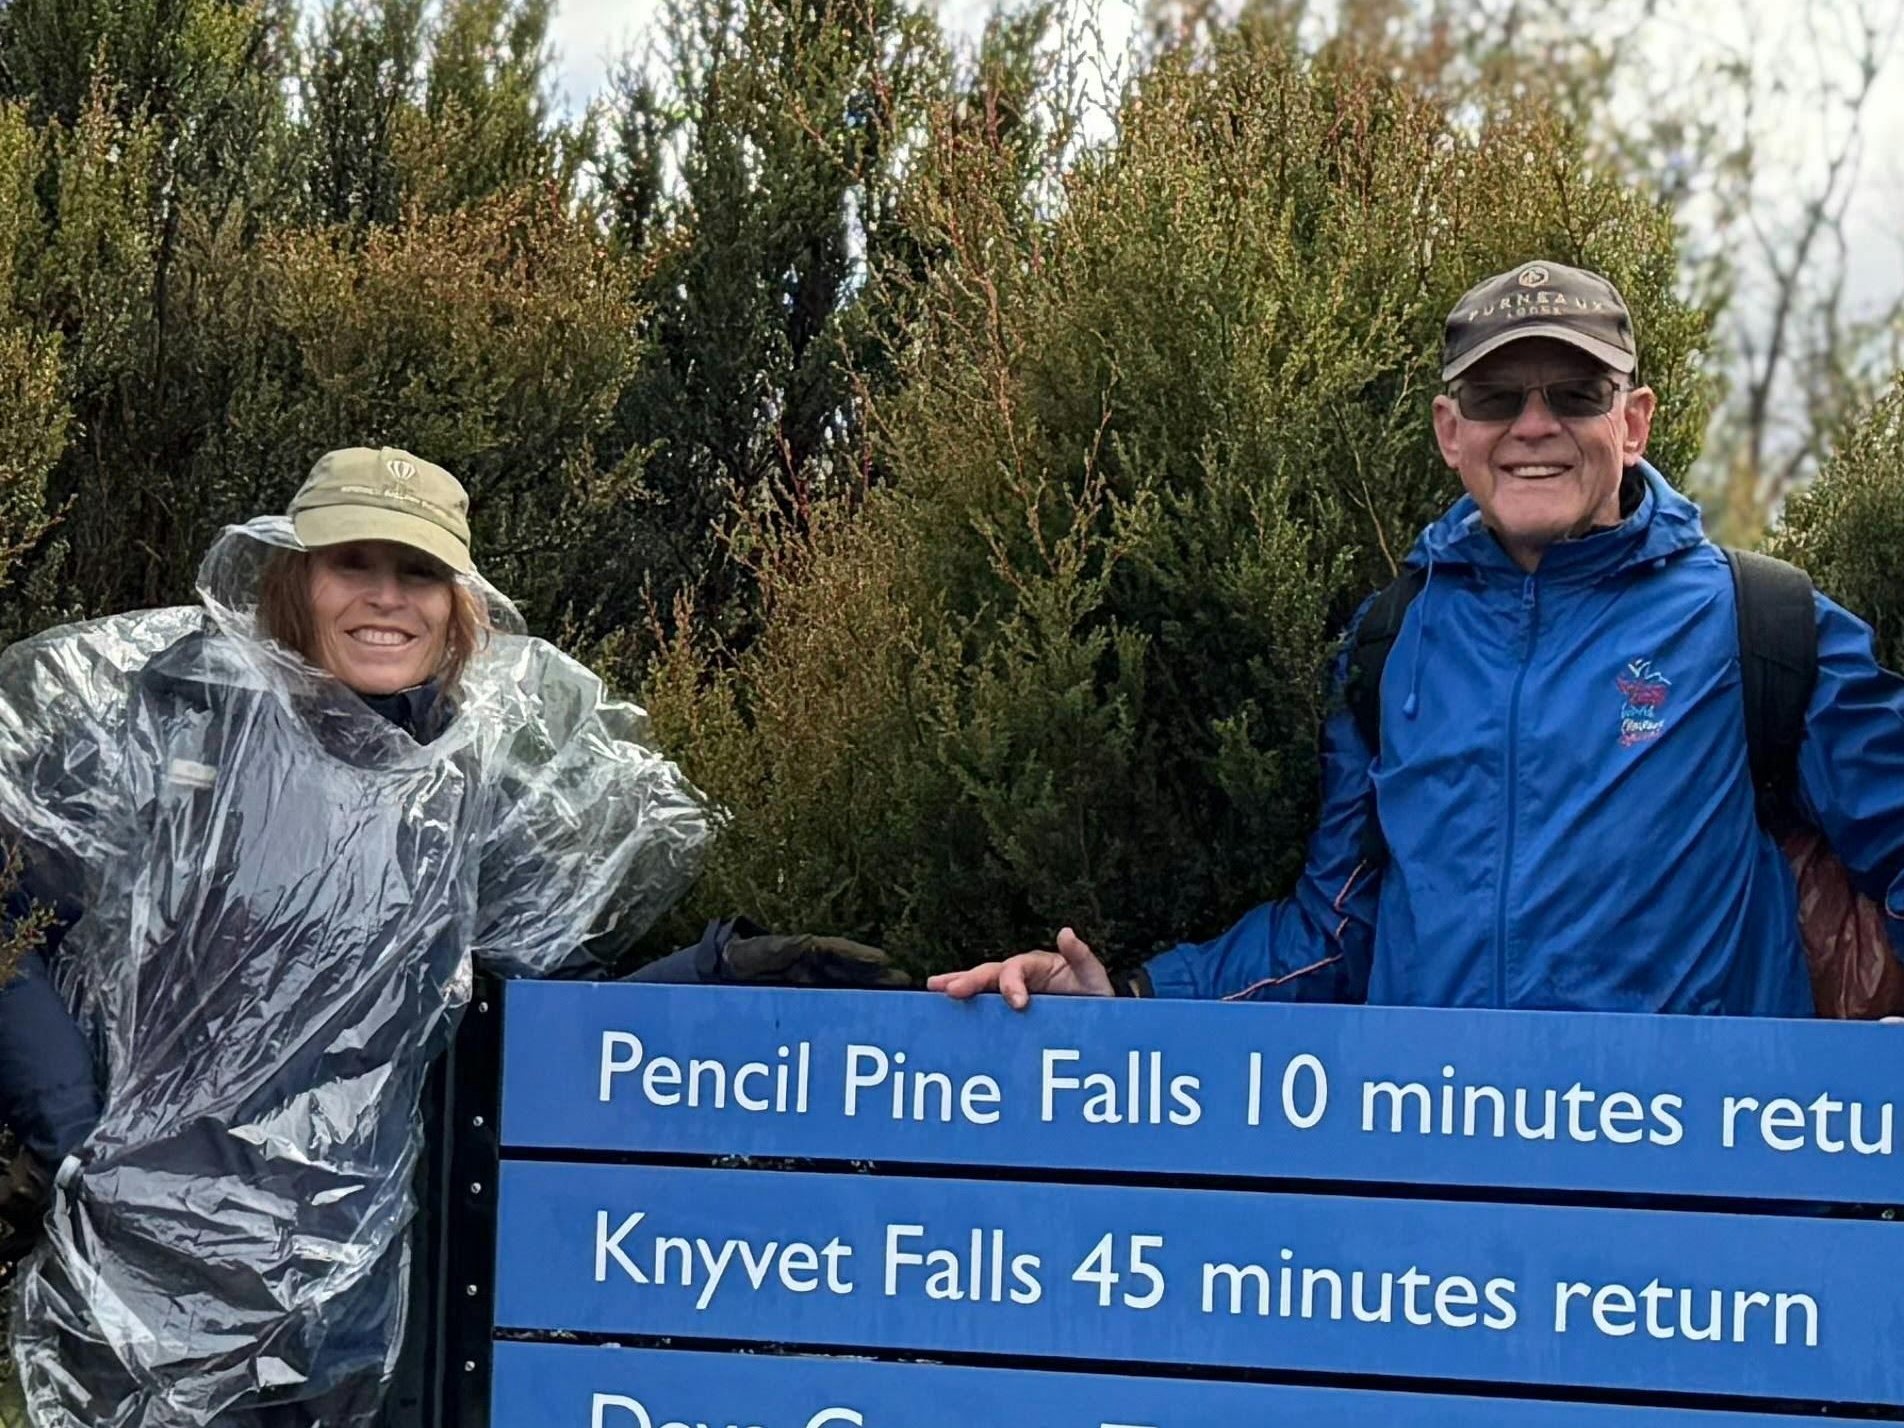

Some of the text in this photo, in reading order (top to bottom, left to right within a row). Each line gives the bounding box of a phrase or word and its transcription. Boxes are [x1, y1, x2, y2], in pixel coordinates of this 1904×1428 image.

[598, 1029, 811, 1114] Pencil
[843, 1043, 1002, 1126] Pine
[1040, 1047, 1203, 1127] Falls
[1246, 1051, 1329, 1130] 10
[1361, 1064, 1684, 1147] minutes
[594, 1209, 1819, 1348] Knyvet Falls 45 minutes return
